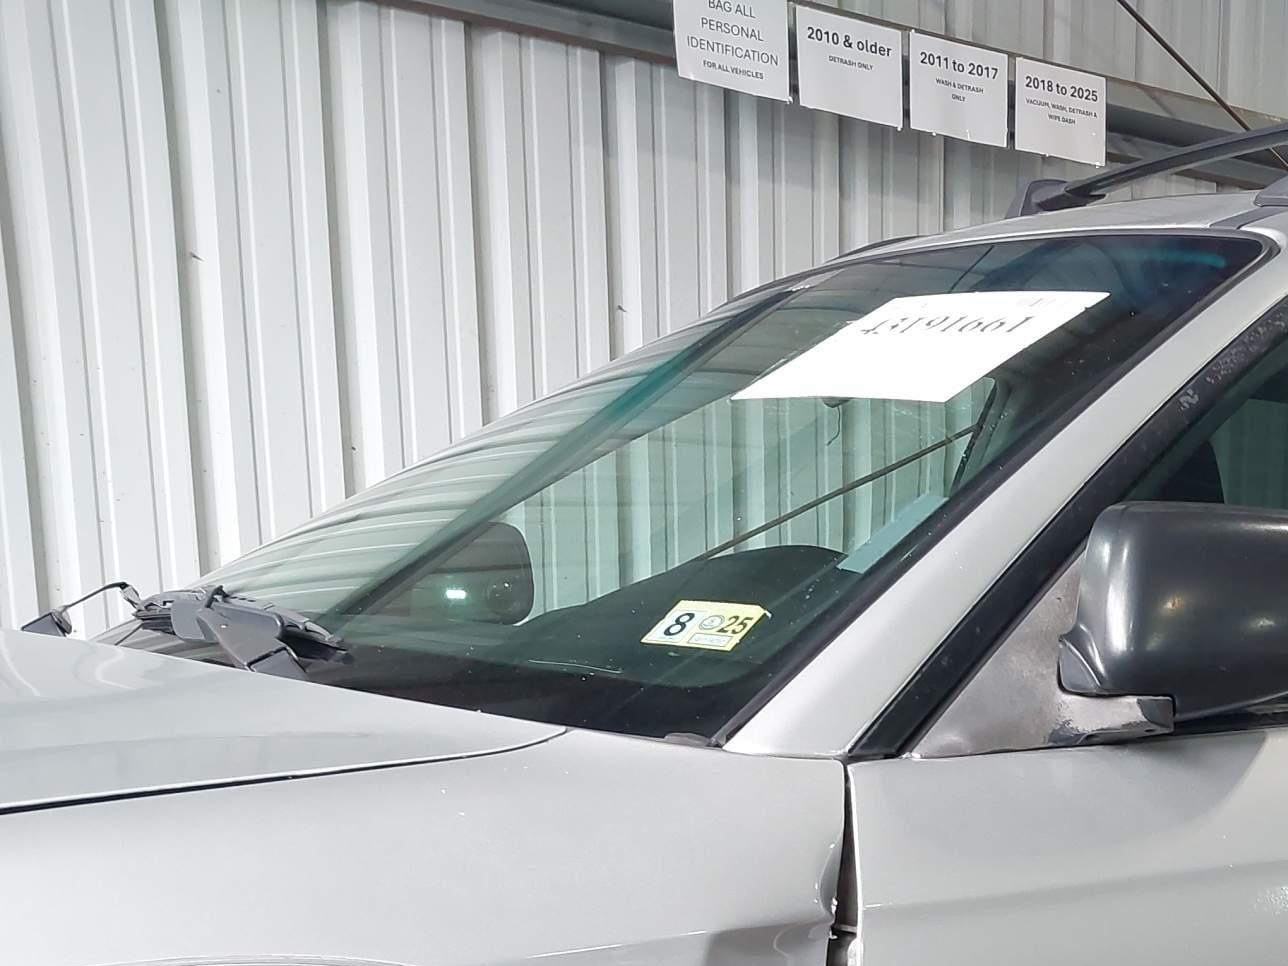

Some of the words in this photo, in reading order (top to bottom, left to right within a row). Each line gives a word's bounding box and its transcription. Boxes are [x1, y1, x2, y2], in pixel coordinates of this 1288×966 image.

[708, 0, 732, 12] BAG
[735, 4, 756, 18] ALL
[701, 17, 764, 41] PERSONAL
[687, 35, 778, 66] IDENTIFICATION
[807, 26, 839, 45] 2010
[843, 35, 853, 48] &
[857, 40, 892, 57] older
[703, 60, 717, 70] FOR
[718, 64, 730, 73] ALL
[731, 67, 764, 79] VEHICLES
[828, 55, 857, 68] DETRASH
[857, 62, 874, 70] ONLY
[920, 51, 949, 70] 2011
[952, 60, 965, 73] to
[968, 62, 998, 80] 2017
[936, 78, 952, 87] WASH
[957, 83, 984, 93] DETRASH
[1025, 75, 1053, 92] 2018
[1056, 83, 1067, 95] to
[1070, 86, 1098, 102] 2025
[951, 93, 966, 102] ONLY
[1068, 107, 1093, 117] DETRASH
[663, 612, 695, 636] 8
[716, 615, 754, 634] 25
